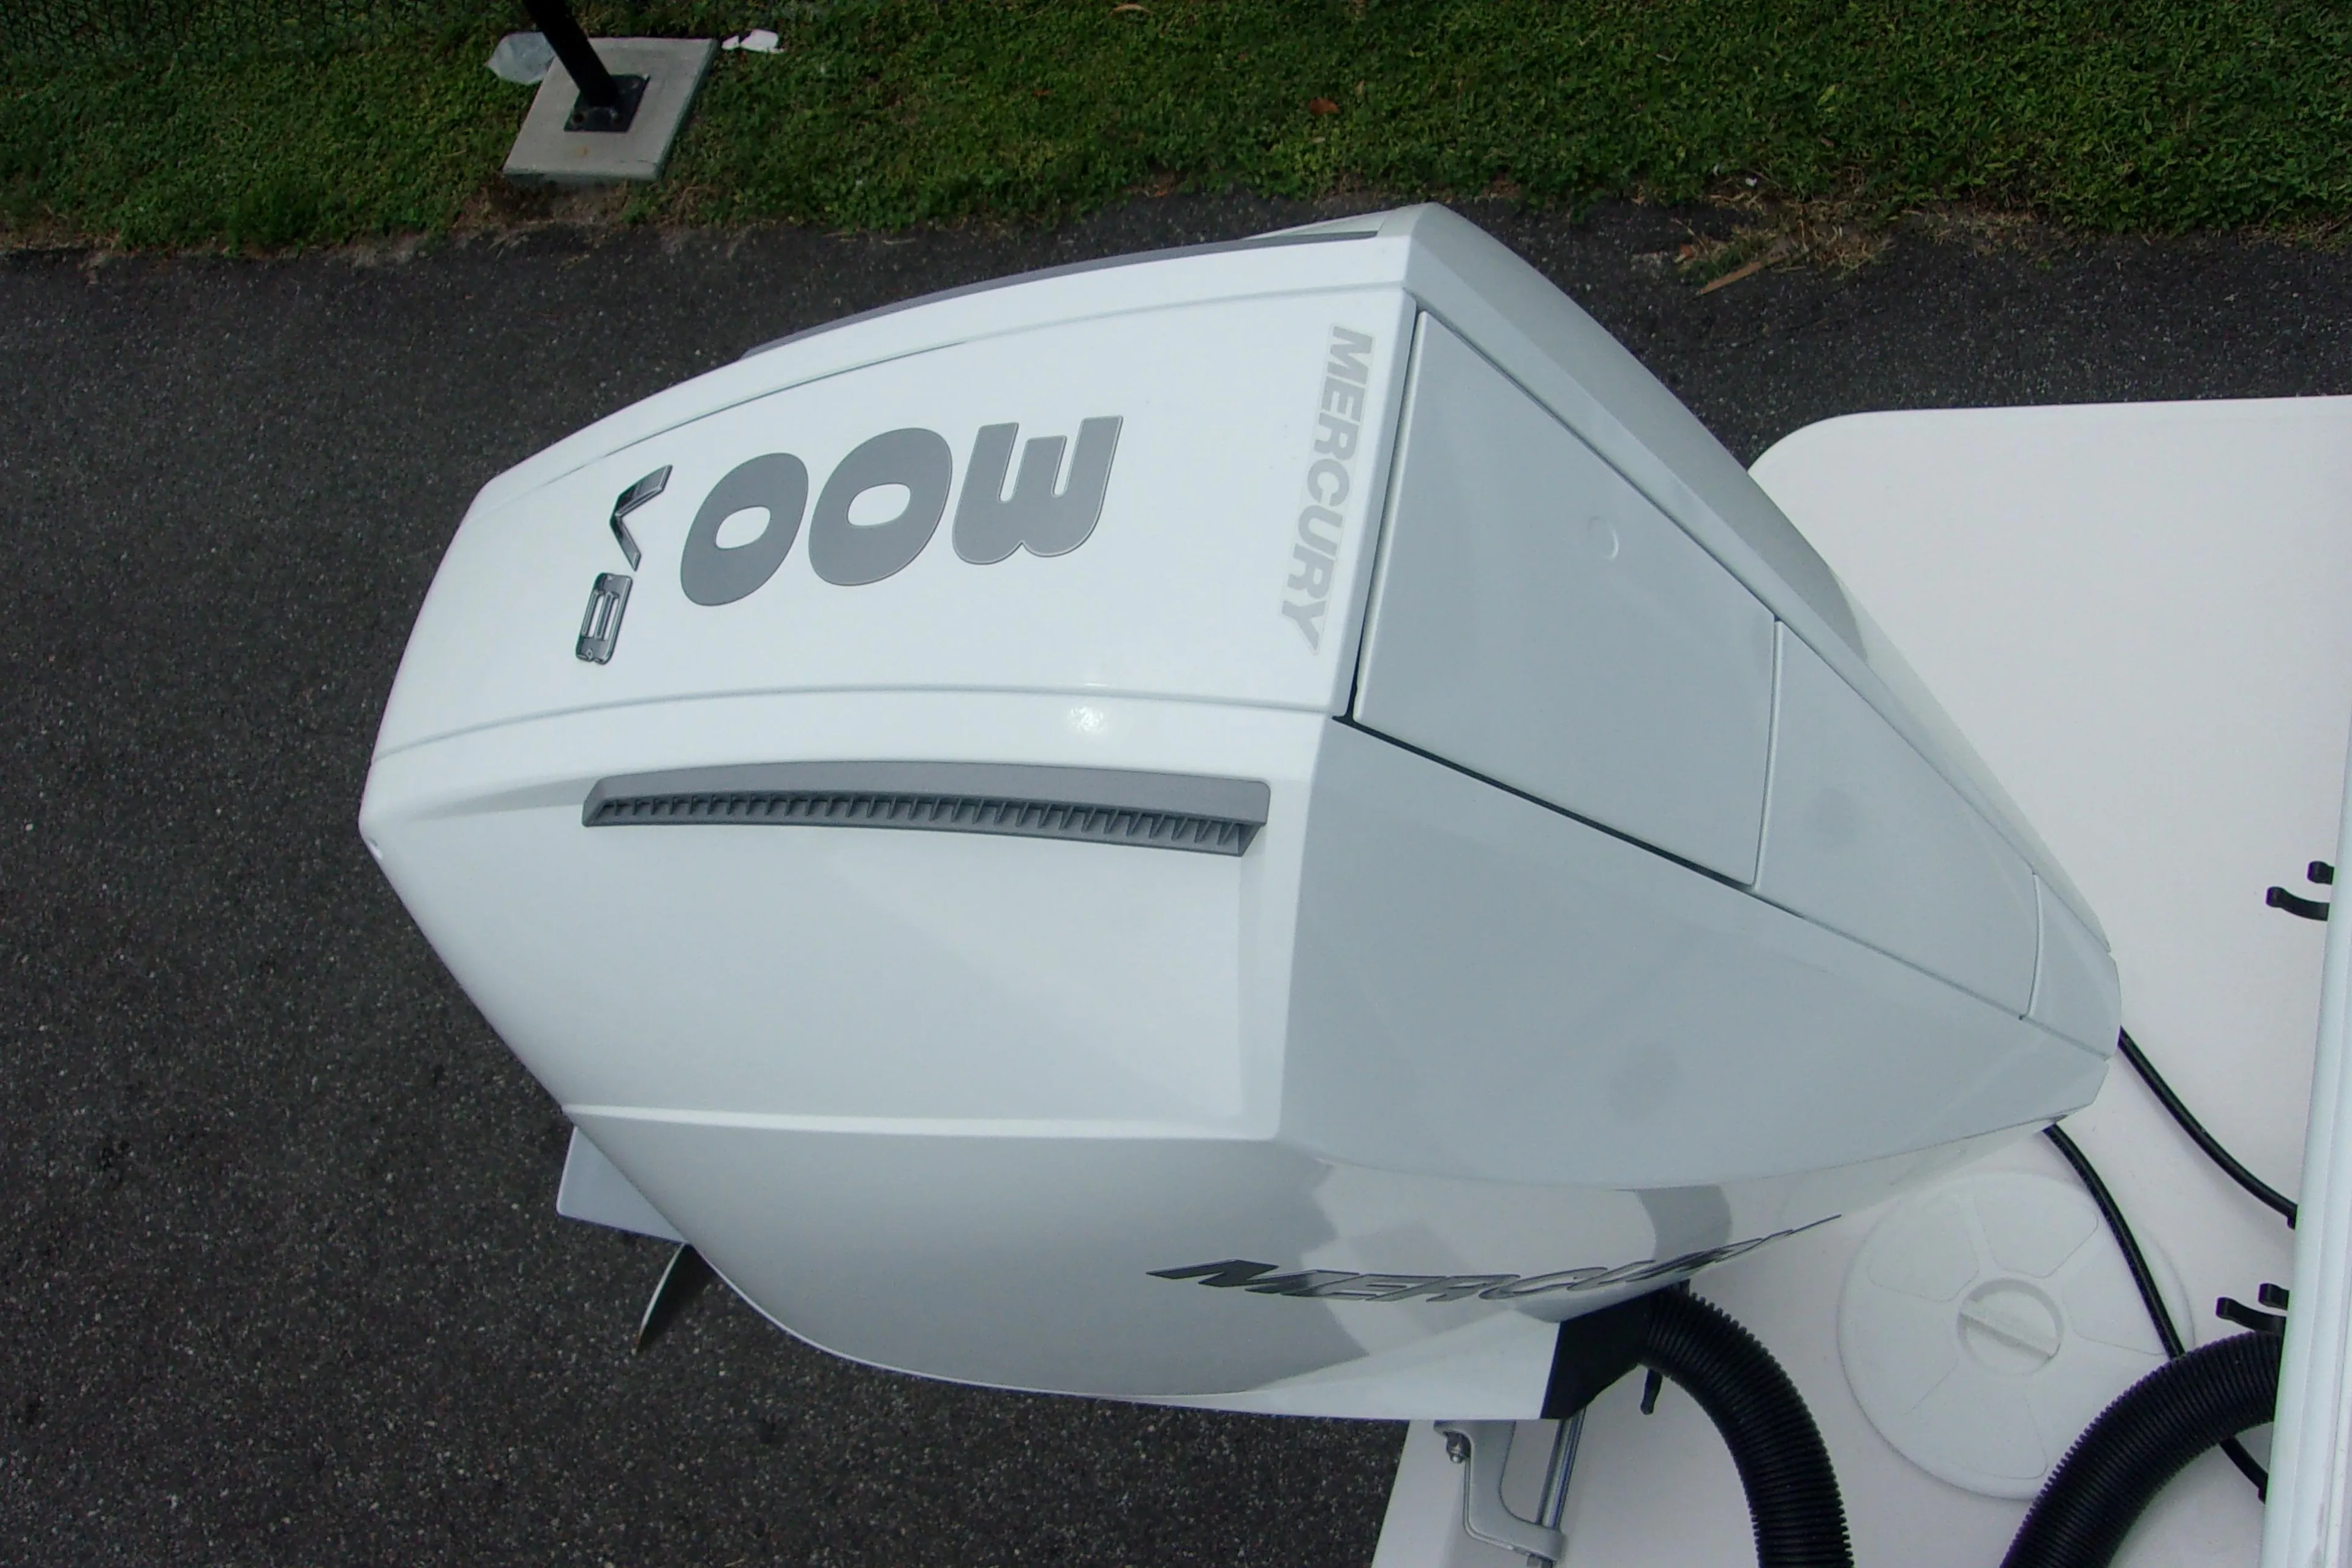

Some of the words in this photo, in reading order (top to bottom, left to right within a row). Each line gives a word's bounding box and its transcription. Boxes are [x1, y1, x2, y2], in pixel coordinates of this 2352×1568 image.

[575, 464, 673, 665] V8
[680, 415, 1123, 606] 300
[1281, 326, 1373, 651] MERCURY
